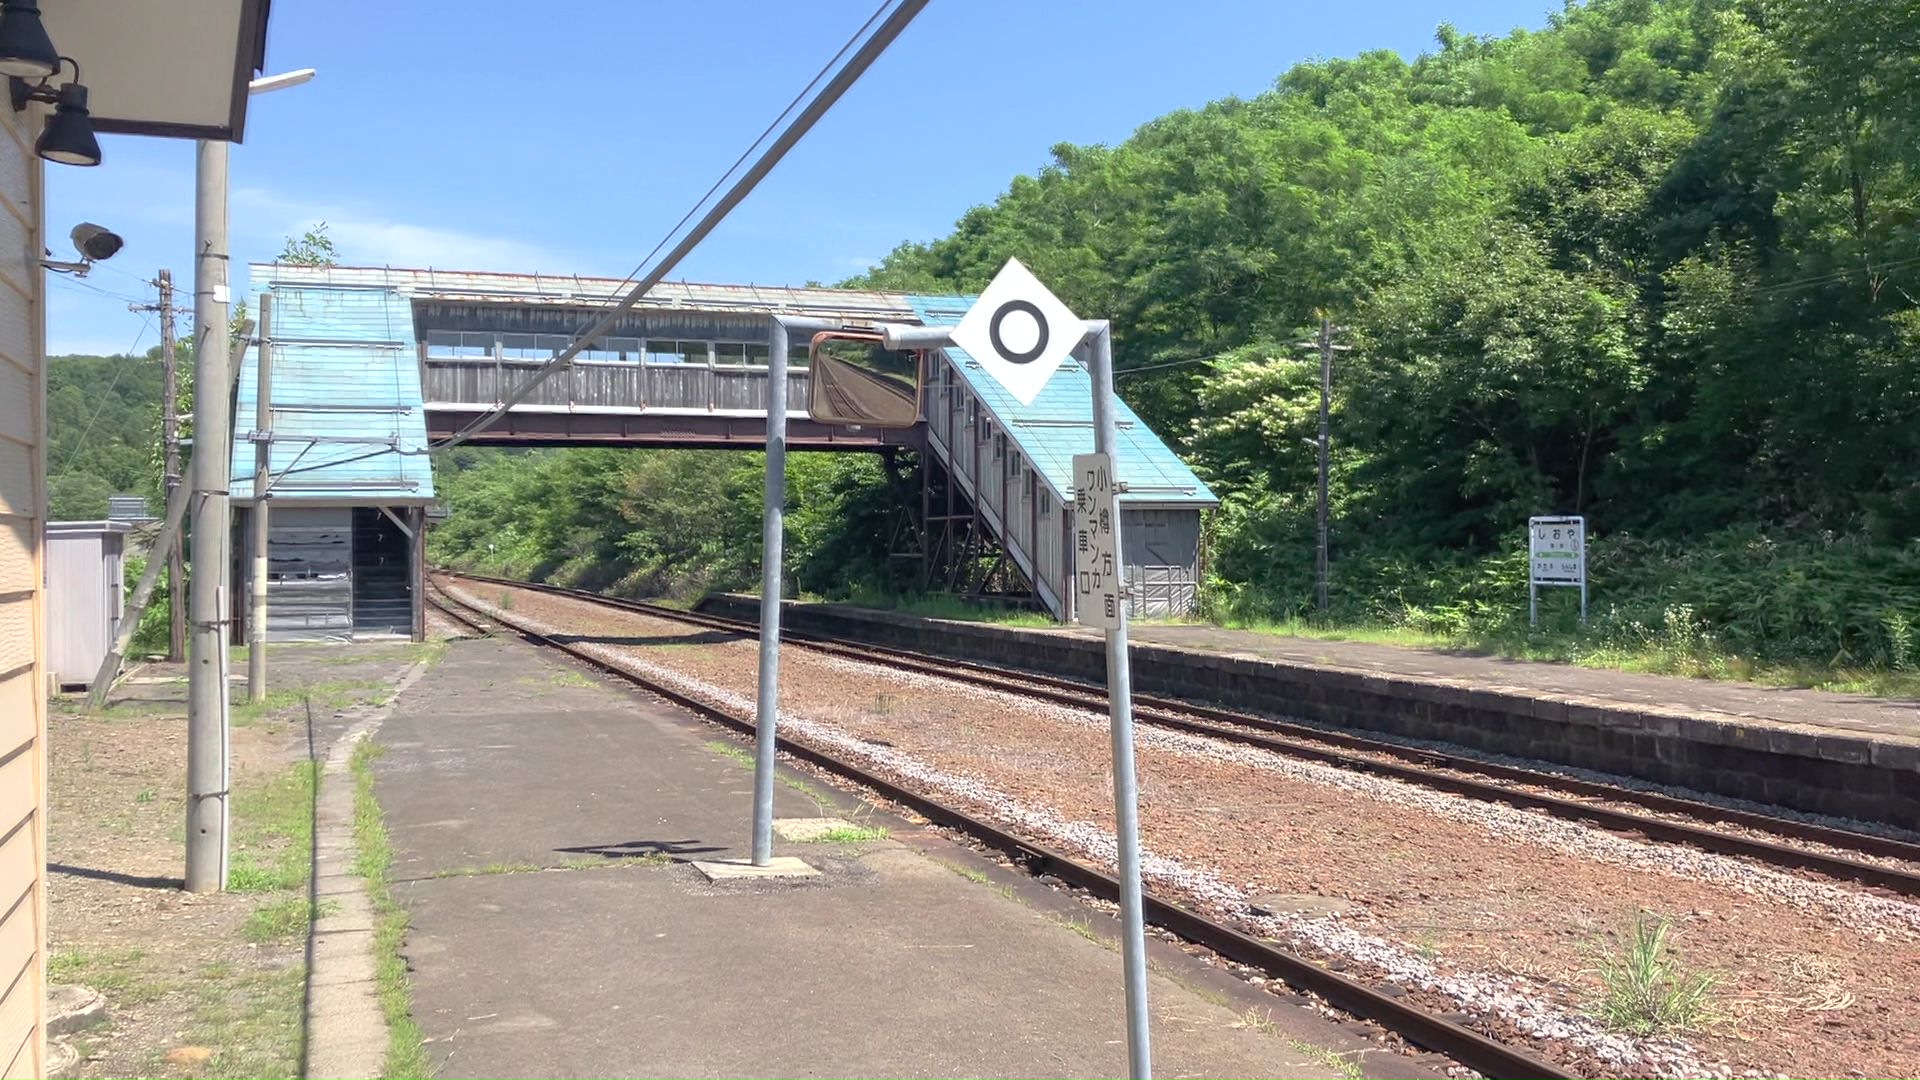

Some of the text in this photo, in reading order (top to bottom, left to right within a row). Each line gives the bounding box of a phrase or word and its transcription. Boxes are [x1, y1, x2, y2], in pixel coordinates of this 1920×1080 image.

[1076, 488, 1090, 595] 乗車口
[1097, 466, 1115, 618] 小樽方面
[1538, 528, 1576, 540] しおや
